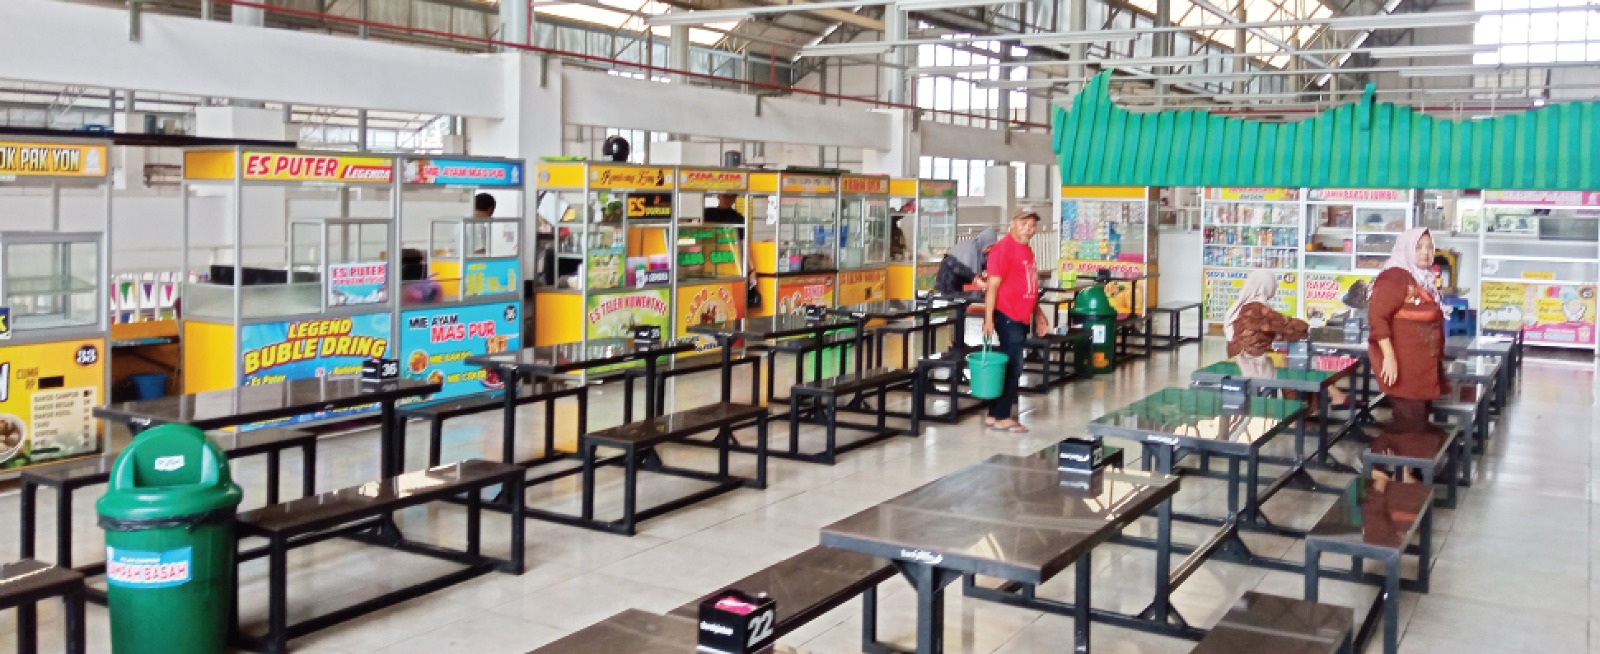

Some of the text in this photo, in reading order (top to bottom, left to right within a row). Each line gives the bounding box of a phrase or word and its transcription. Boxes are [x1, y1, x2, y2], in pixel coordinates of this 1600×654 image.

[20, 147, 49, 171] PAK
[52, 148, 80, 171] YON
[245, 156, 339, 177] ES PUTER
[424, 166, 505, 179] MIE AYAM MAS PUR
[627, 196, 647, 217] ES
[349, 264, 385, 277] PUTER
[288, 317, 353, 341] LEGEND
[408, 314, 458, 329] MIE AYAM
[431, 320, 496, 342] MAS PUR
[244, 335, 387, 375] BUBLE DRING
[16, 367, 38, 379] CUMA
[381, 362, 398, 377] 36
[144, 565, 187, 581] BASAH
[747, 609, 774, 647] 22
